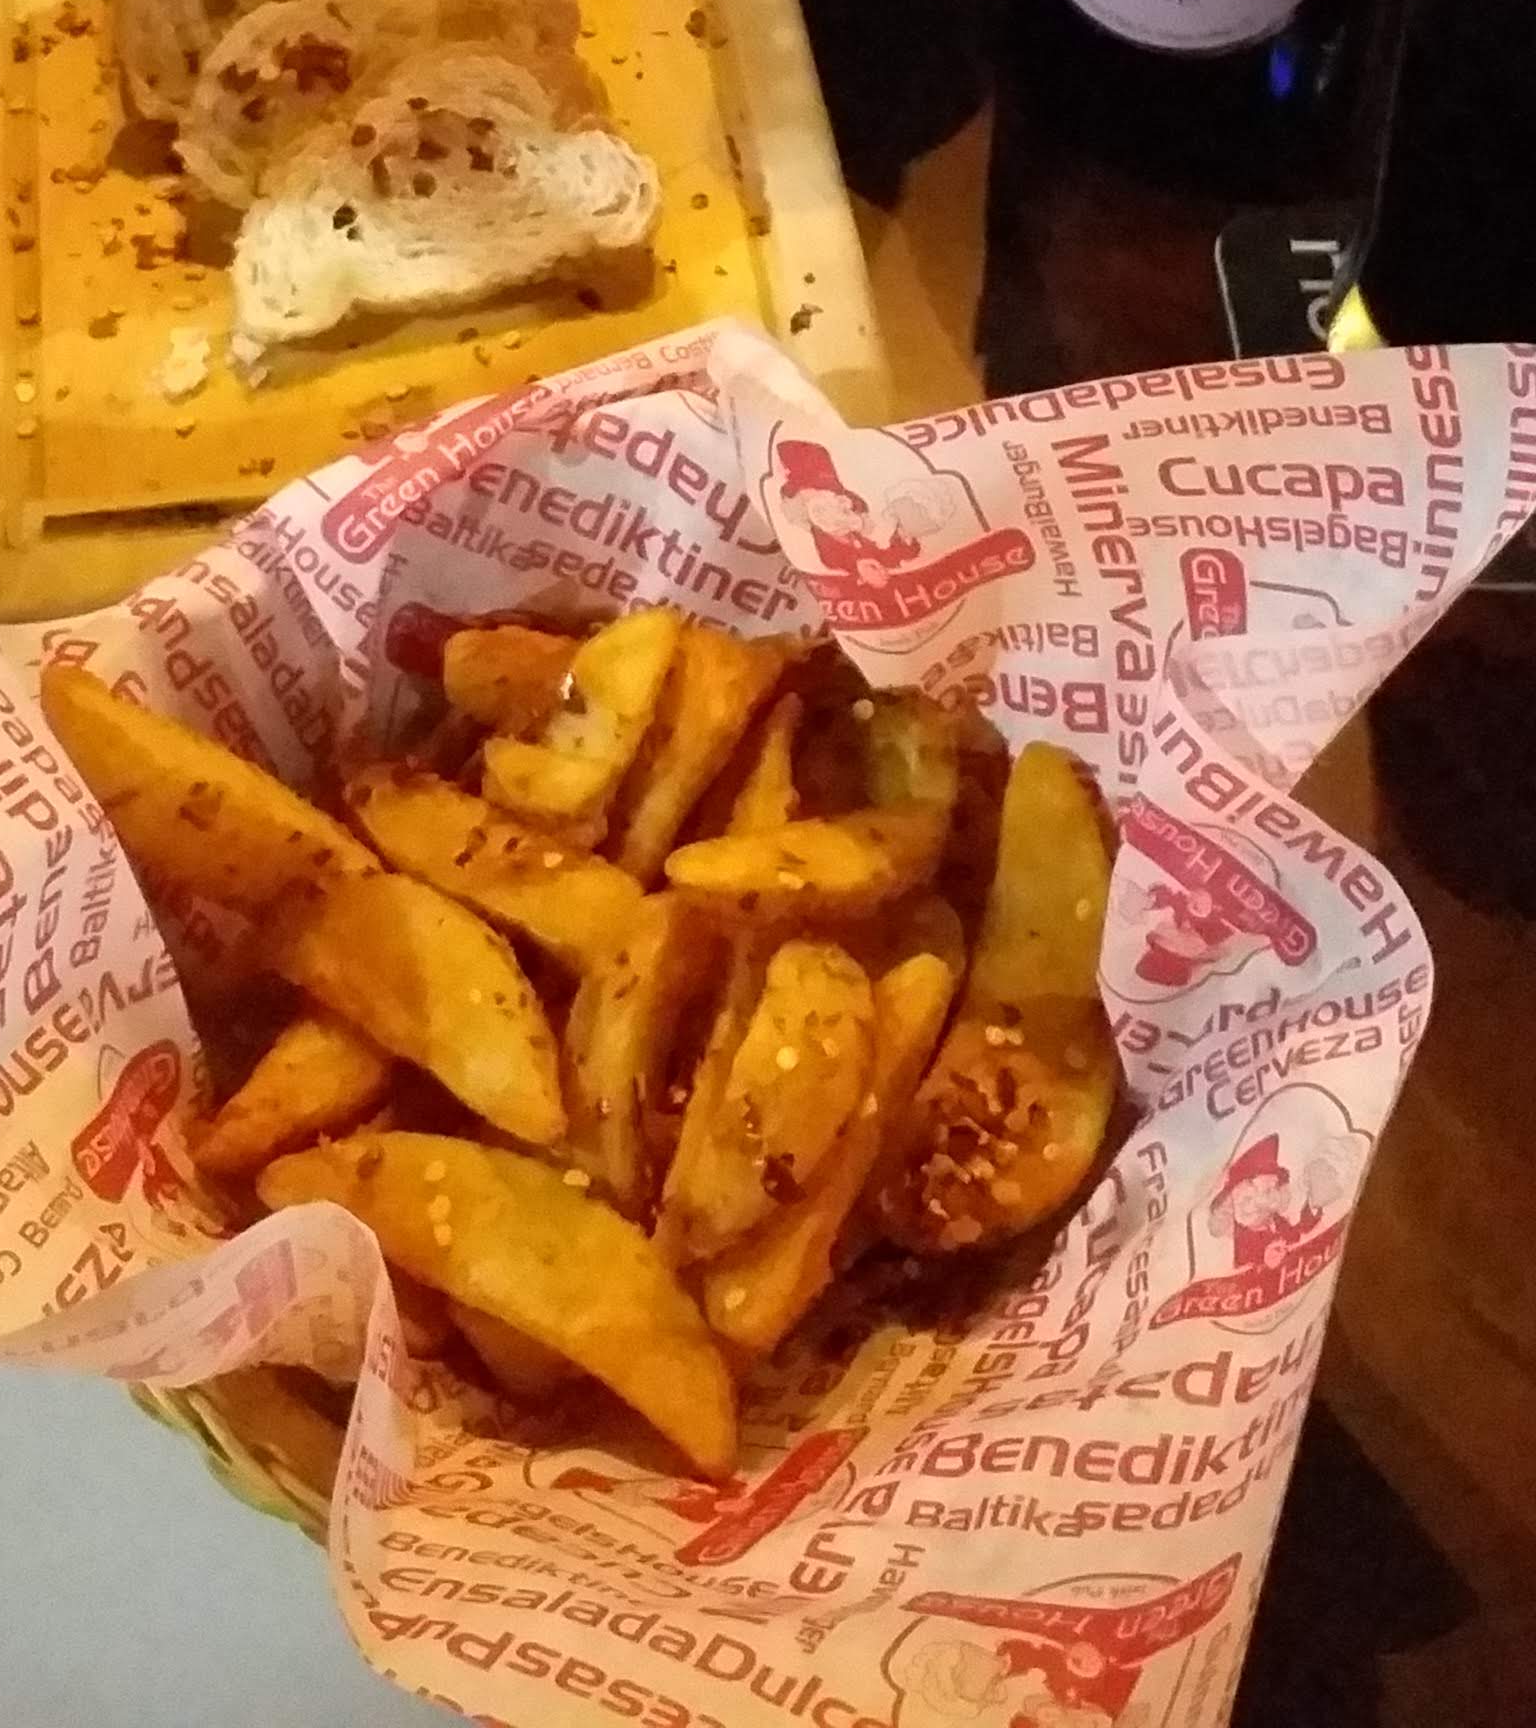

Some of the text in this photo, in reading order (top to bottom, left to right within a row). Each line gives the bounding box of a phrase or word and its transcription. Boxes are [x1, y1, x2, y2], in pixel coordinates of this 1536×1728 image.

[908, 354, 1347, 448] EnsaladaDulce
[1121, 402, 1393, 442] Benediktiner
[337, 384, 552, 556] Green House
[1158, 457, 1406, 512] Cucapa
[466, 459, 799, 625] enediktiner
[894, 546, 1029, 620] House
[1050, 433, 1157, 684] Minerva
[1126, 514, 1409, 570] BagelsHouse
[1206, 1023, 1383, 1122] Cerveza
